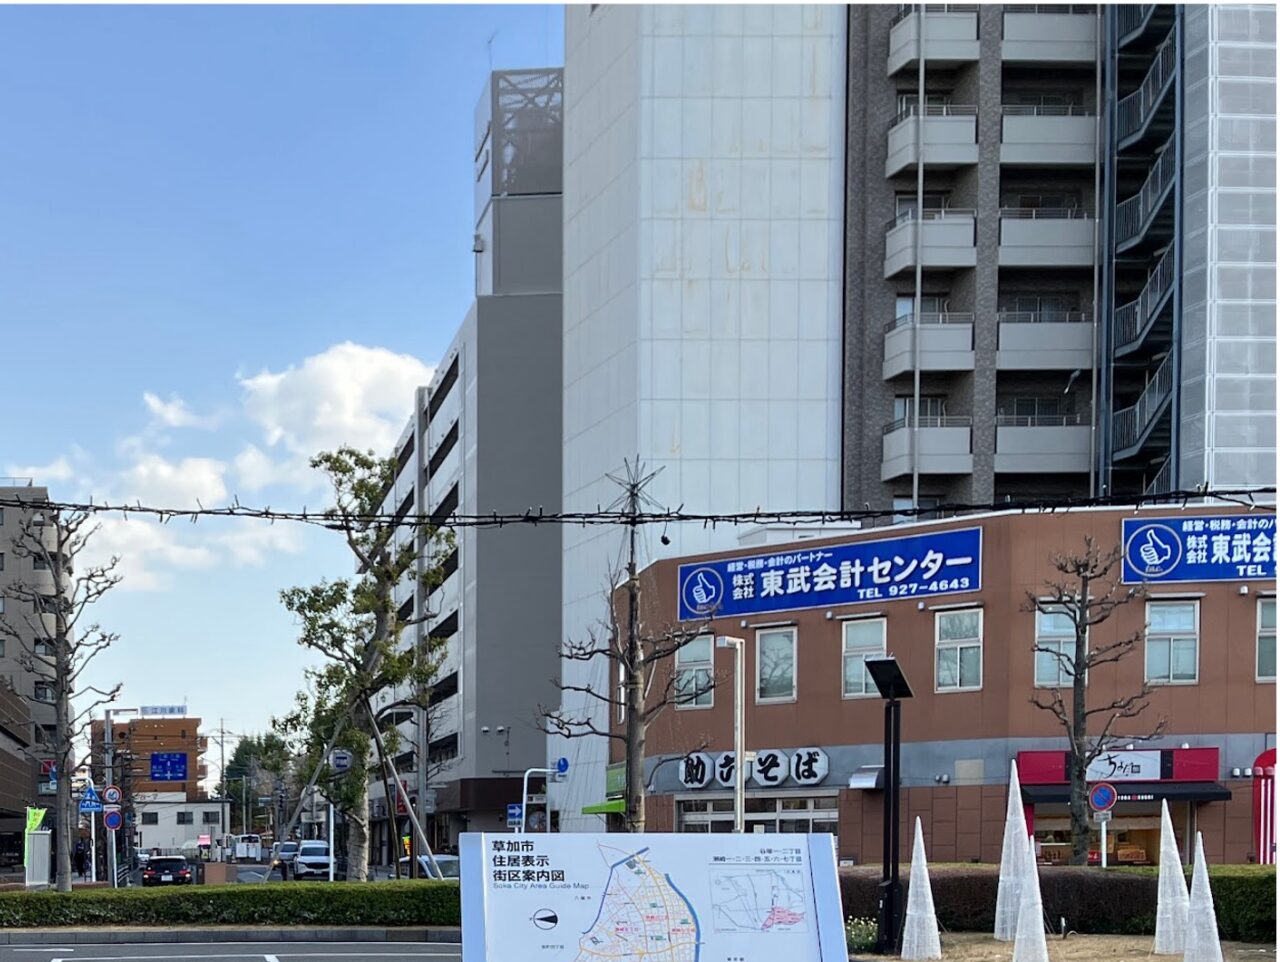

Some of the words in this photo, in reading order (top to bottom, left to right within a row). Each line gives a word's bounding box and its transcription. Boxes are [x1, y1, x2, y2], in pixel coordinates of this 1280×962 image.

[1186, 535, 1208, 549] 株式
[1186, 549, 1208, 564] 会社
[760, 550, 973, 597] 東武会計センター
[1236, 565, 1267, 577] TEL
[732, 573, 755, 587] 株式
[732, 587, 755, 601] 会社
[857, 588, 883, 600] TEL
[888, 577, 970, 597] 927-4643
[492, 840, 534, 852] 草加市
[492, 854, 550, 867] 住居表示
[493, 869, 565, 882] 街区案内図
[513, 882, 528, 890] City
[573, 882, 590, 890] Map
